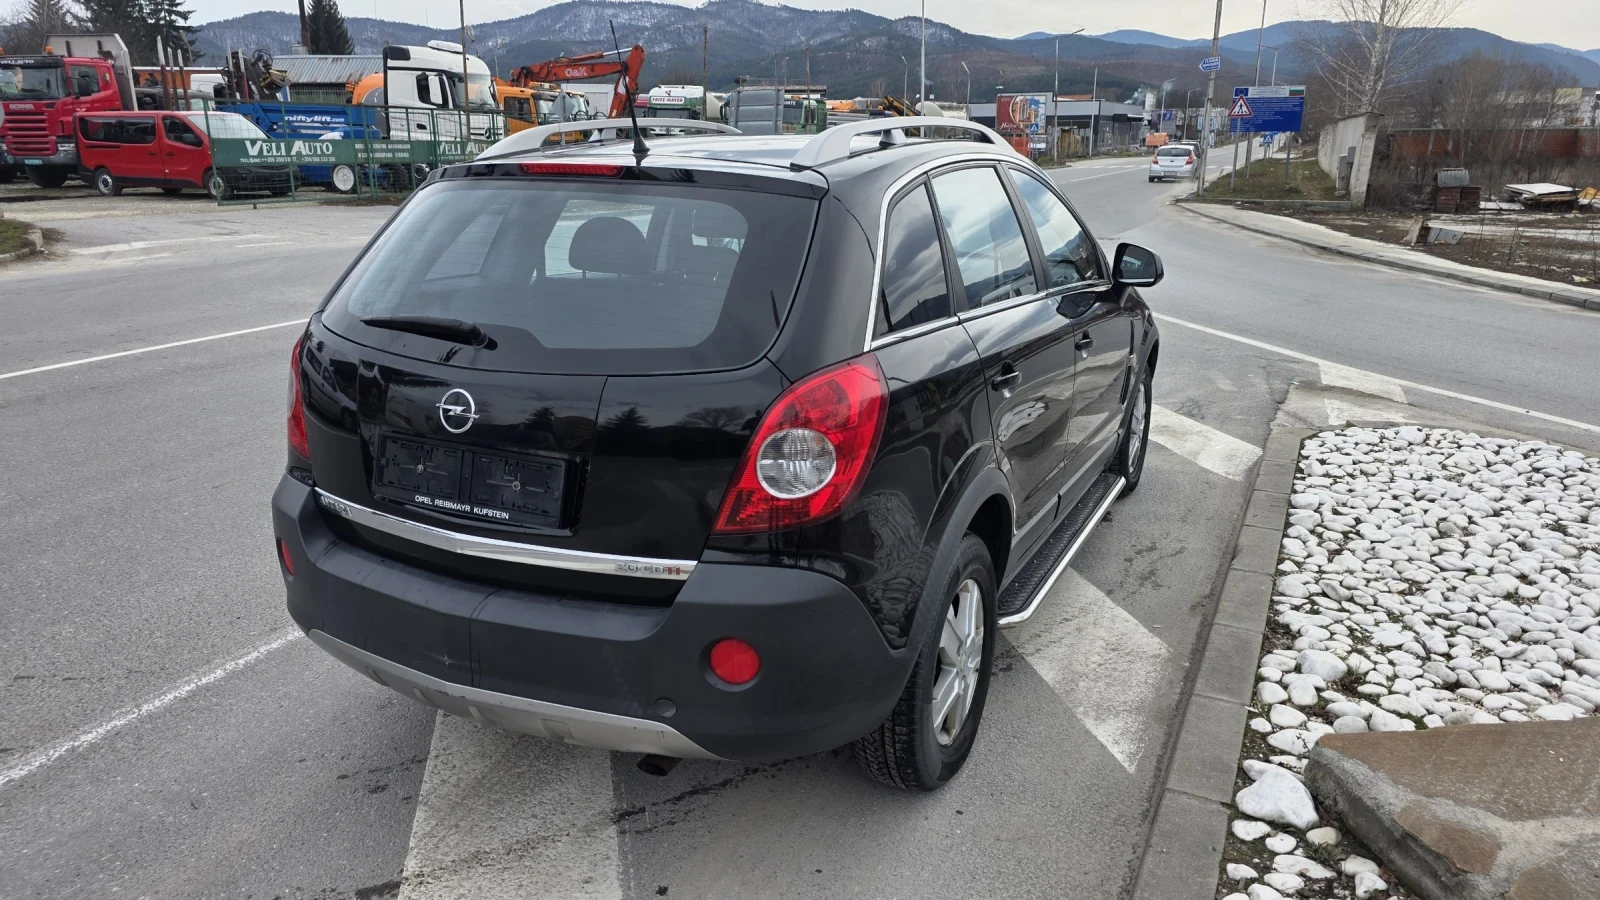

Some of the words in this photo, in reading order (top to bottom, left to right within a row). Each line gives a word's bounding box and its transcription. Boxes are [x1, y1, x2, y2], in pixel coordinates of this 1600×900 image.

[565, 67, 588, 77] O&K
[285, 115, 345, 123] niftylift.com
[415, 495, 433, 505] OPEL
[434, 498, 471, 512] REIBMAYR
[473, 506, 509, 520] KUFSTEIN
